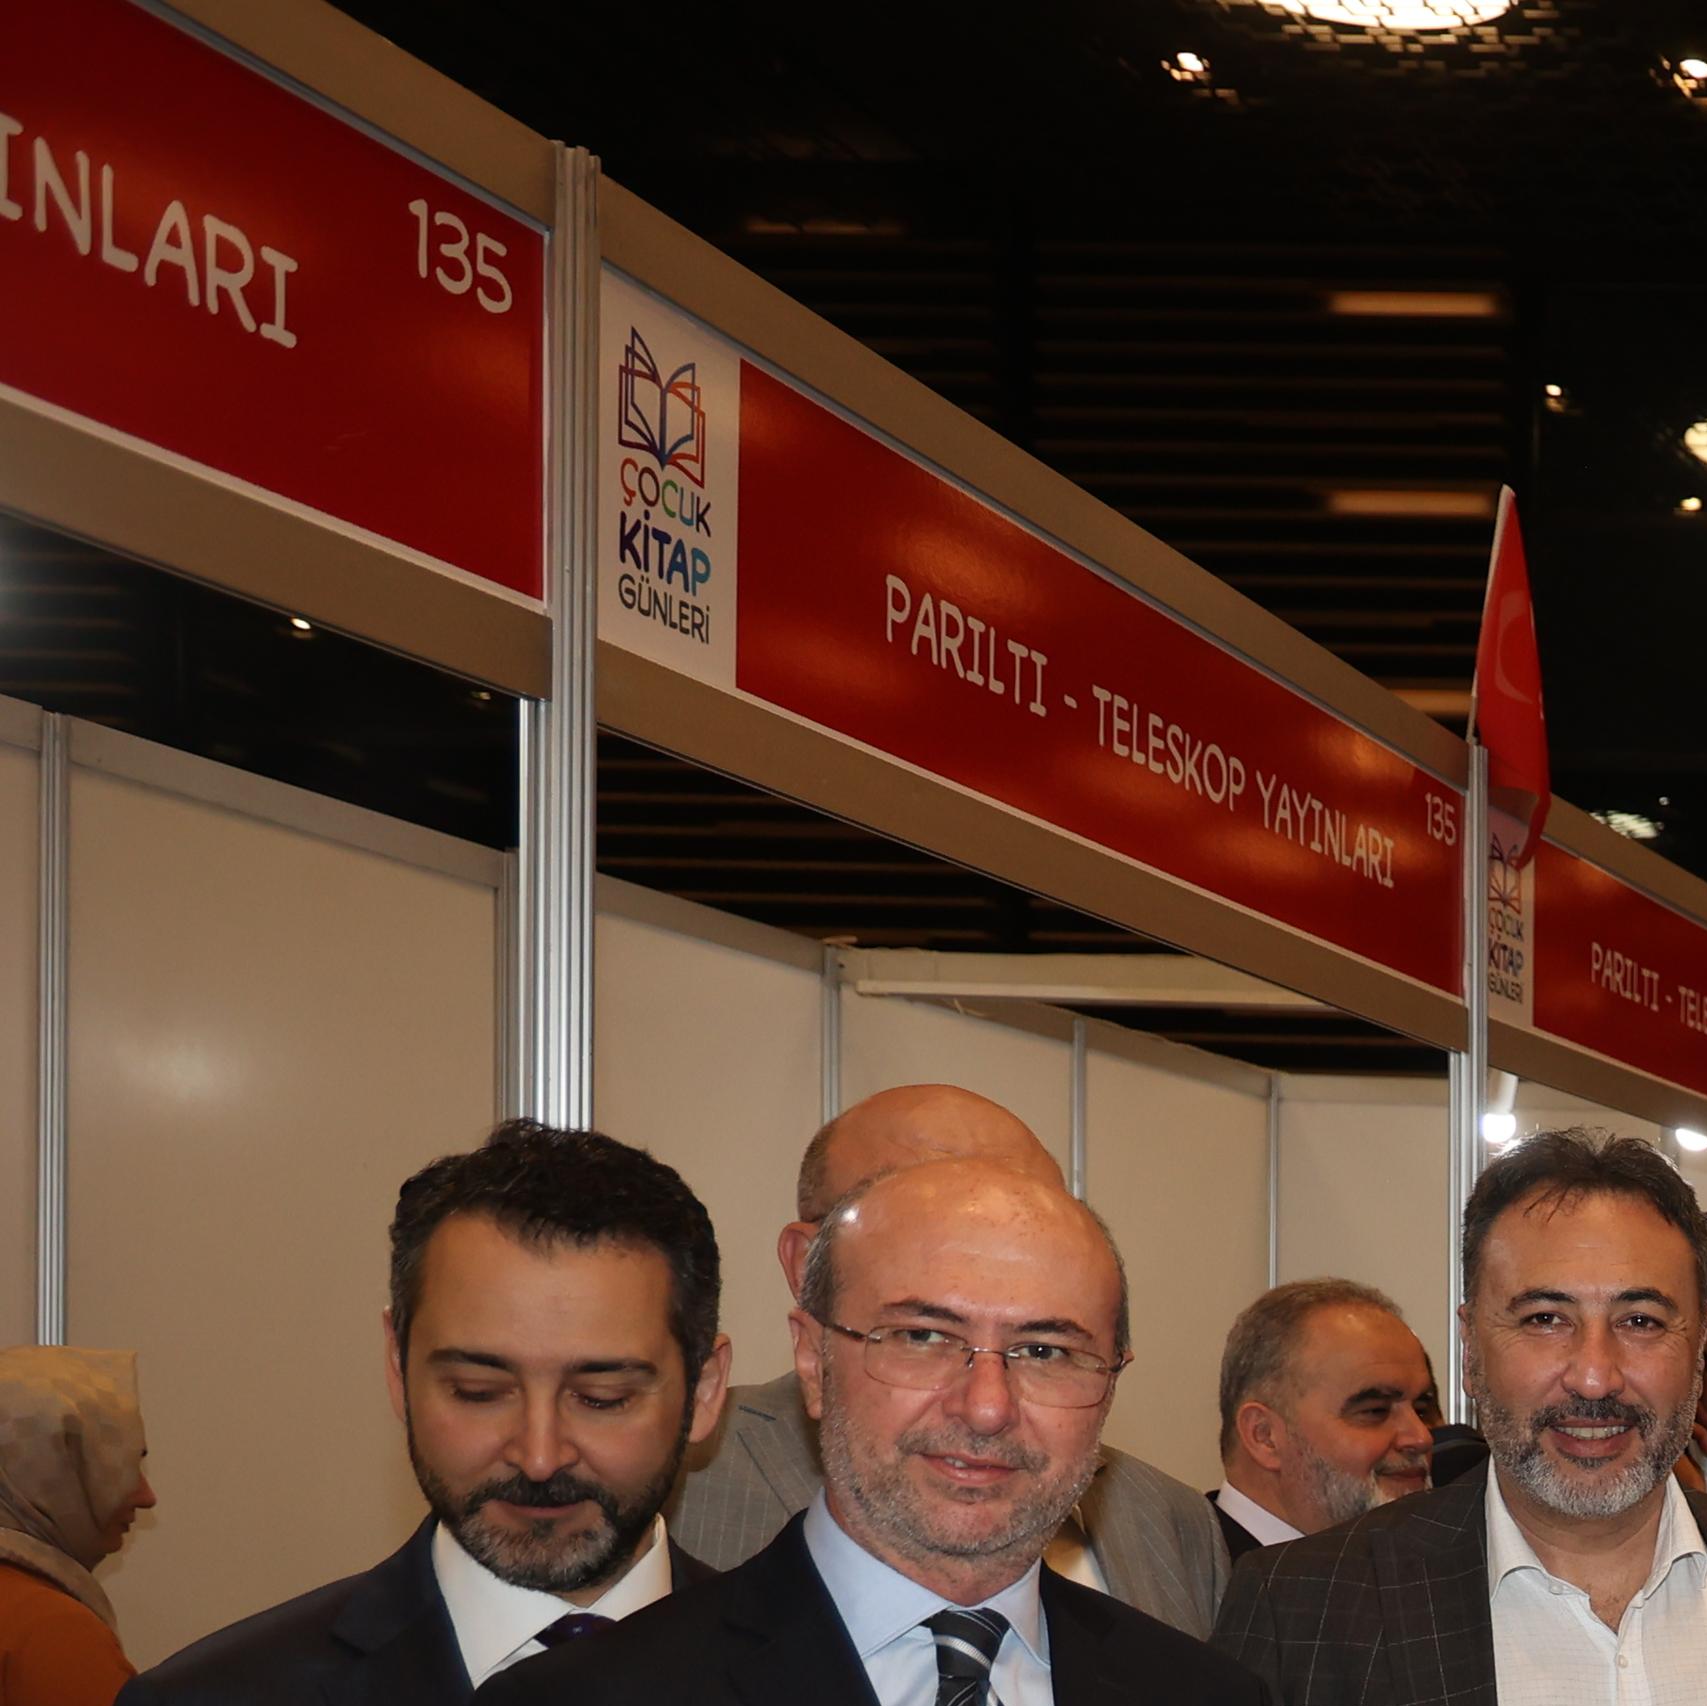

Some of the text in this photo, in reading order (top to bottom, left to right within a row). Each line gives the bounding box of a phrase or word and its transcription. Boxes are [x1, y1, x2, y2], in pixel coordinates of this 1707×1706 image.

[409, 199, 513, 314] 135
[620, 457, 711, 538] ÇOCUK
[619, 509, 711, 597] KİTAP
[618, 573, 710, 645] GÜNLERİ
[886, 574, 1456, 888] PARILTI - TELESKOP YAYINLARI 135
[1591, 941, 1660, 1013] PARILTI
